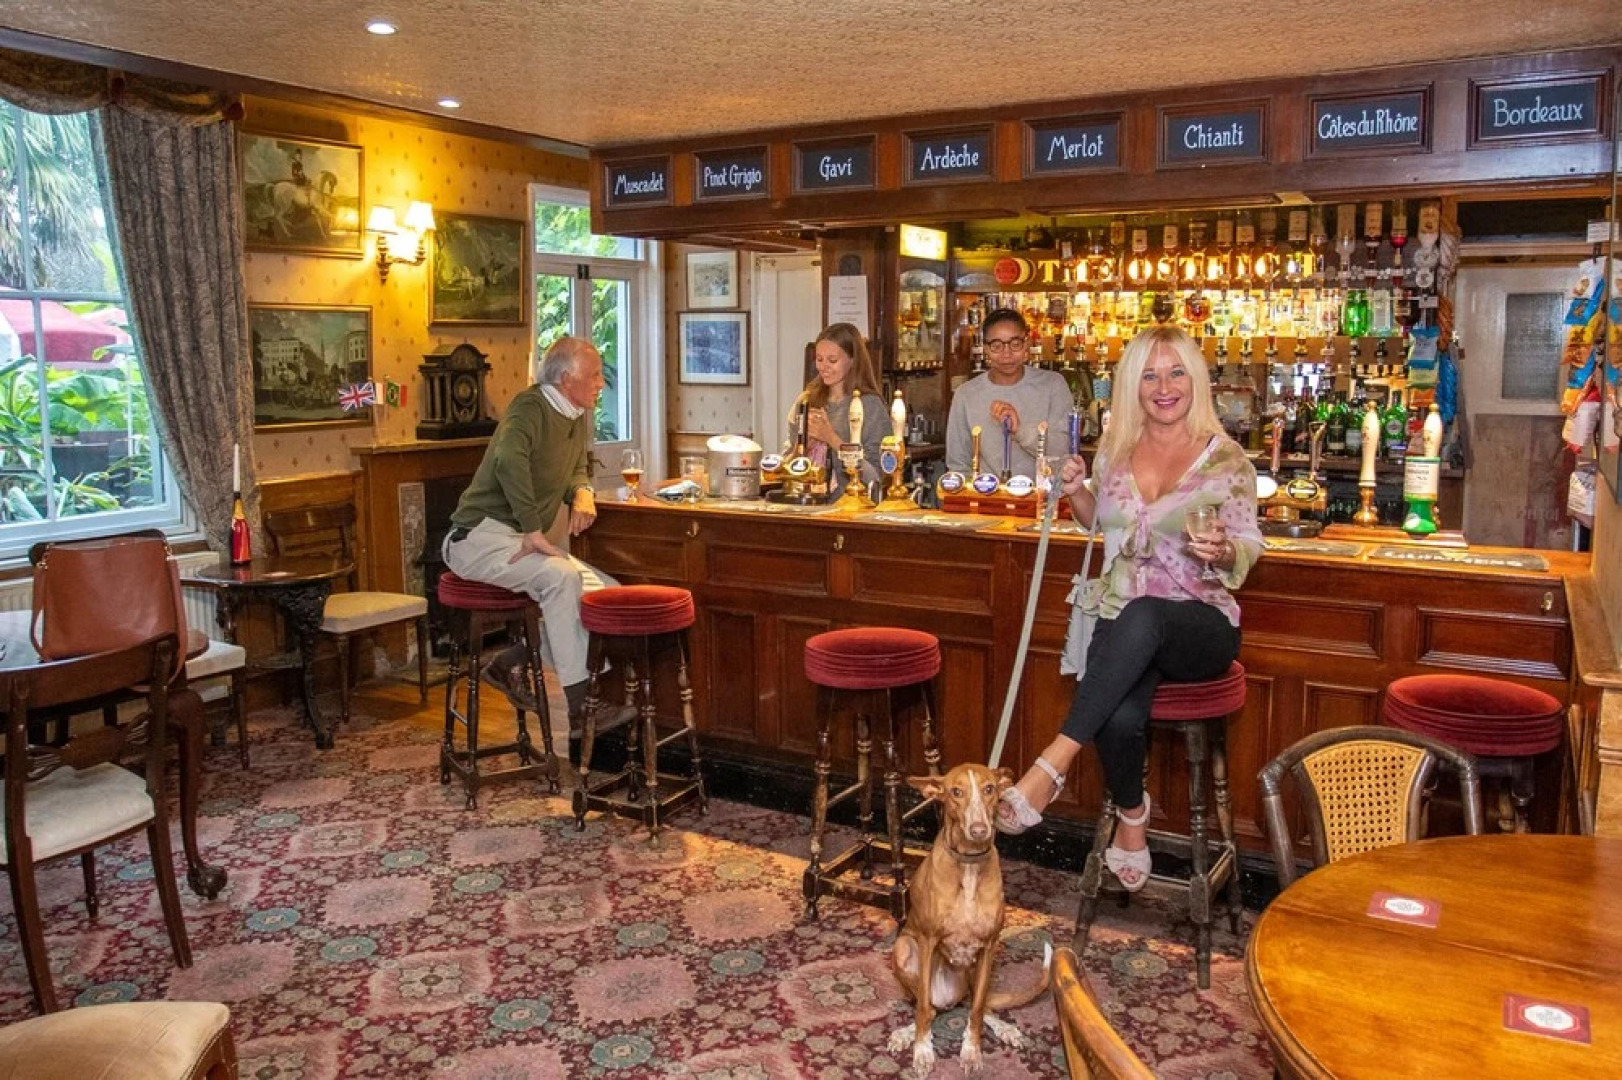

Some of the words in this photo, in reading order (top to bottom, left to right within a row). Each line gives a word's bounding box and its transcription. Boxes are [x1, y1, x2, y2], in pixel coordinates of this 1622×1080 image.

[1318, 113, 1357, 139] Côtes
[1375, 108, 1418, 135] Rhône
[1493, 98, 1583, 128] Bordeaux
[1047, 133, 1104, 161] Merlot
[1183, 124, 1244, 149] Chianti
[819, 155, 852, 181] Gavi
[920, 143, 979, 171] Ardèche
[614, 171, 664, 196] Muscadet
[703, 166, 727, 188] Pinot
[729, 164, 762, 191] Grigio
